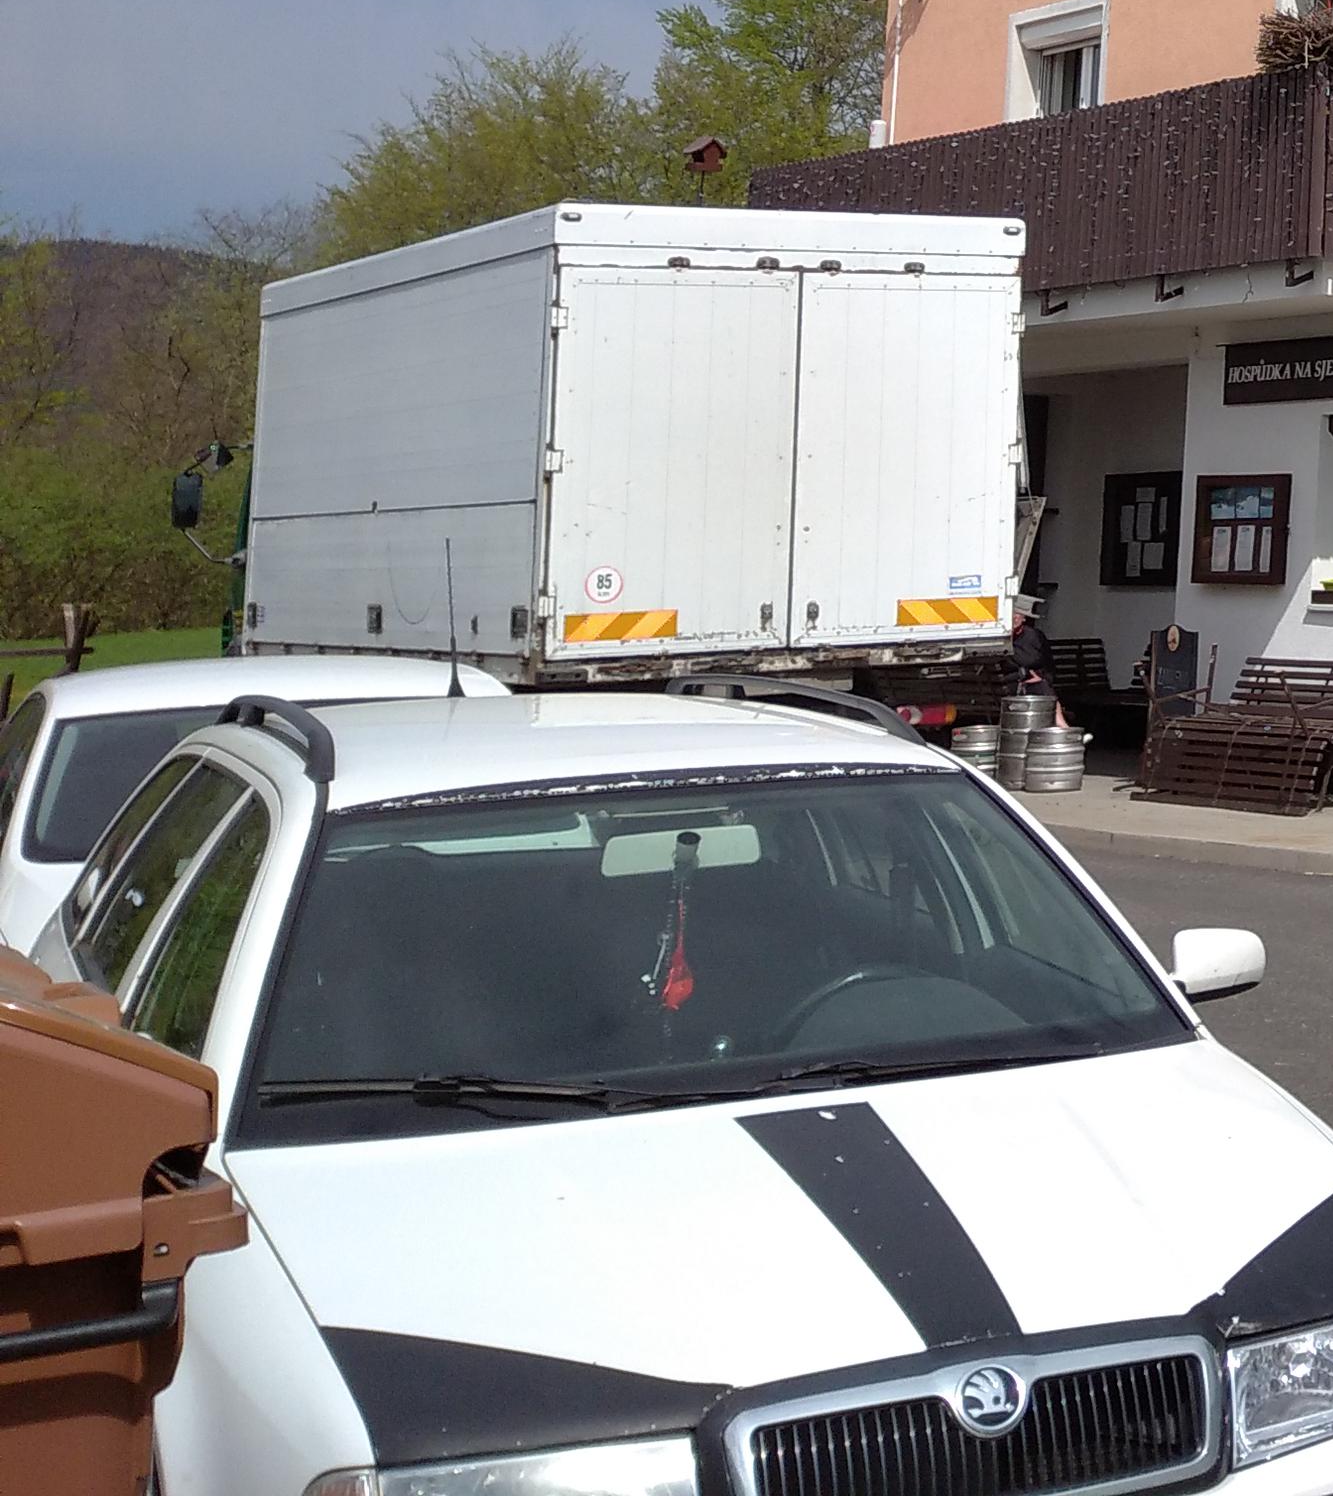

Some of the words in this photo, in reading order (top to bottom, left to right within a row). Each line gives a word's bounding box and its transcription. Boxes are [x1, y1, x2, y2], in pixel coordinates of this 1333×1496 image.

[1228, 358, 1291, 384] HOSPŮDKA
[1294, 361, 1312, 379] NA
[597, 573, 613, 590] 85
